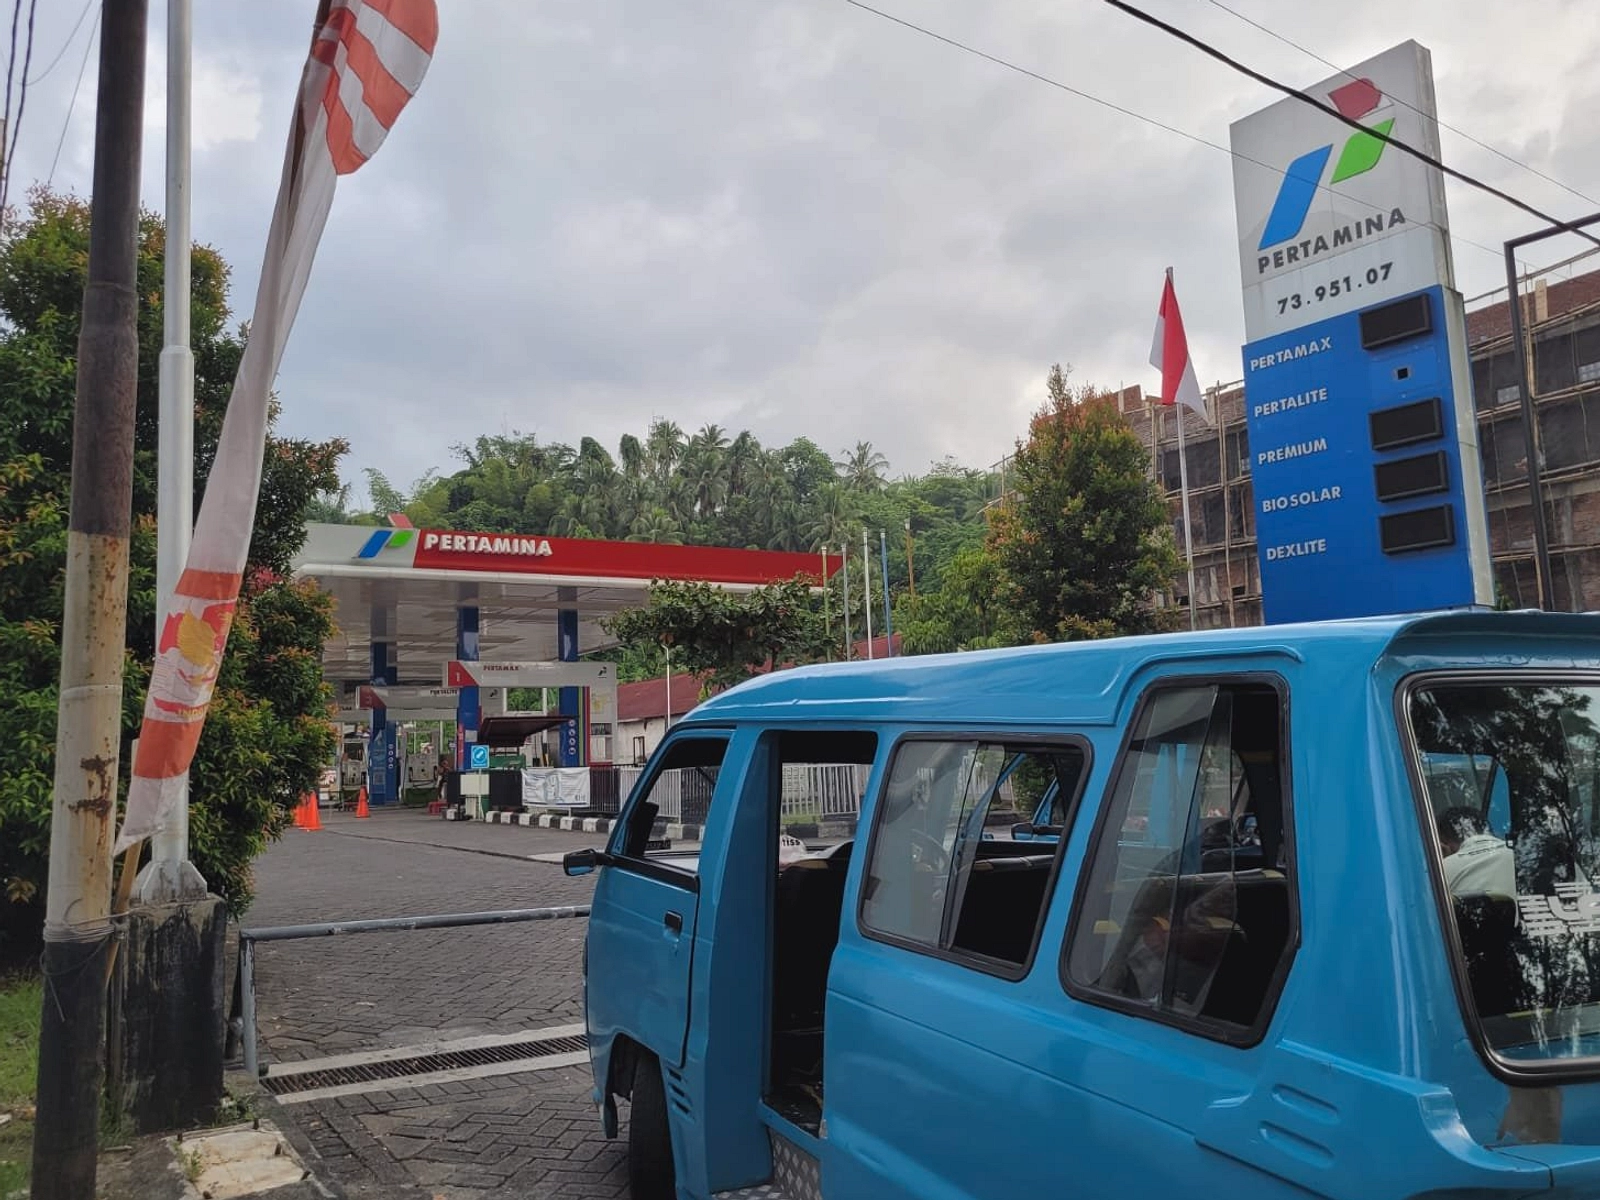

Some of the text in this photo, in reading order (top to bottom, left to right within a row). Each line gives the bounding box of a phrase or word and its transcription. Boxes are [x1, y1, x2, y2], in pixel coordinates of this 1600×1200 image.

[1257, 207, 1406, 274] PERTAMINA
[1277, 261, 1394, 315] 73.951.07
[1250, 336, 1332, 372] PERTAMAX
[1254, 387, 1328, 418] PERTALITE
[1258, 438, 1328, 465] PREMIUM
[424, 533, 553, 557] PERTAMINA
[1266, 538, 1327, 561] DEXLITE
